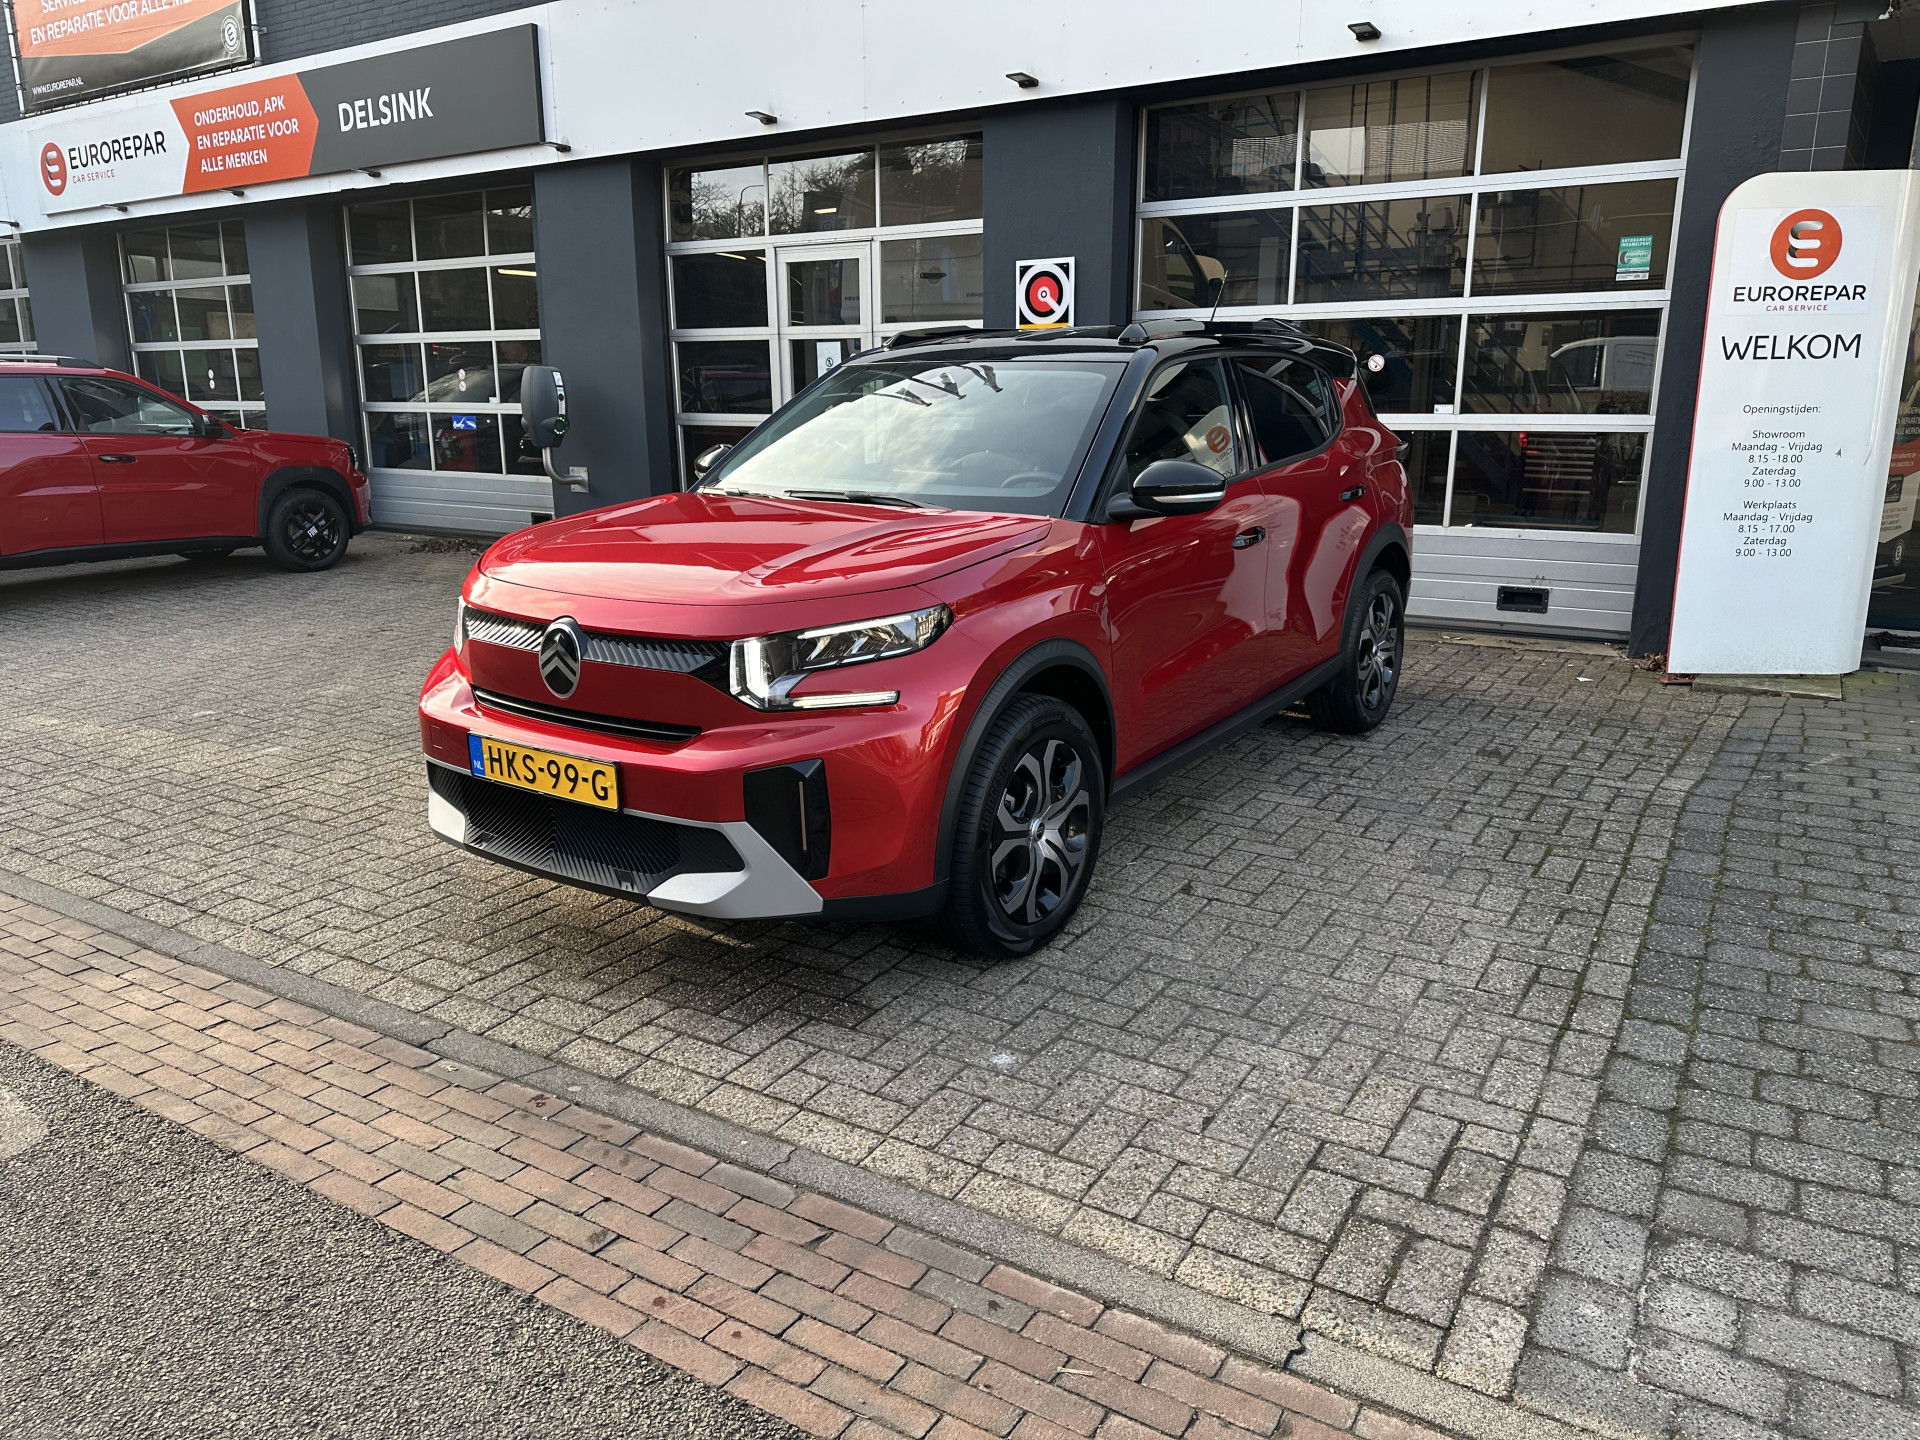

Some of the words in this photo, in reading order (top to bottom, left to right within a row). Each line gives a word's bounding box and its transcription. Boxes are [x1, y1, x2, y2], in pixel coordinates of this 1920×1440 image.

[42, 0, 87, 13] SERV
[30, 27, 46, 45] EN
[47, 9, 105, 39] REPARATIE
[105, 1, 139, 24] VOOR
[141, 0, 171, 16] ALLE
[194, 100, 262, 127] ONDERHOUD,
[264, 95, 286, 113] APK
[338, 87, 434, 132] DELSINK
[197, 133, 211, 150] EN
[212, 125, 266, 148] REPARATIE
[267, 118, 300, 138] VOOR
[68, 130, 167, 170] EUROREPAR
[200, 156, 224, 173] ALLE
[226, 148, 268, 171] MERKEN
[72, 173, 86, 184] CAR
[87, 169, 116, 182] SERVICE
[1733, 285, 1867, 302] EUROREPAR
[1721, 333, 1862, 361] WELKOM
[1743, 405, 1821, 415] Openingstijden:
[1752, 430, 1805, 439] Showroom
[1731, 442, 1778, 452] Maandag
[1788, 442, 1823, 453] Vrijdag
[1748, 454, 1769, 463] 8.15
[1752, 467, 1796, 477] Zaterdag
[1744, 479, 1764, 488] 9.00
[1775, 479, 1801, 488] 13.00
[1743, 501, 1797, 510] Werkplaats
[1723, 512, 1769, 523] Maandag
[1779, 512, 1813, 523] Vrijdag
[1738, 525, 1758, 533] 8.15
[1769, 525, 1795, 533] 17.00
[1743, 536, 1787, 547] Zaterdag
[1735, 548, 1756, 557] 9.00
[1766, 548, 1792, 557] 13.00
[473, 759, 484, 770] NL
[487, 744, 609, 801] HKS-99-G
